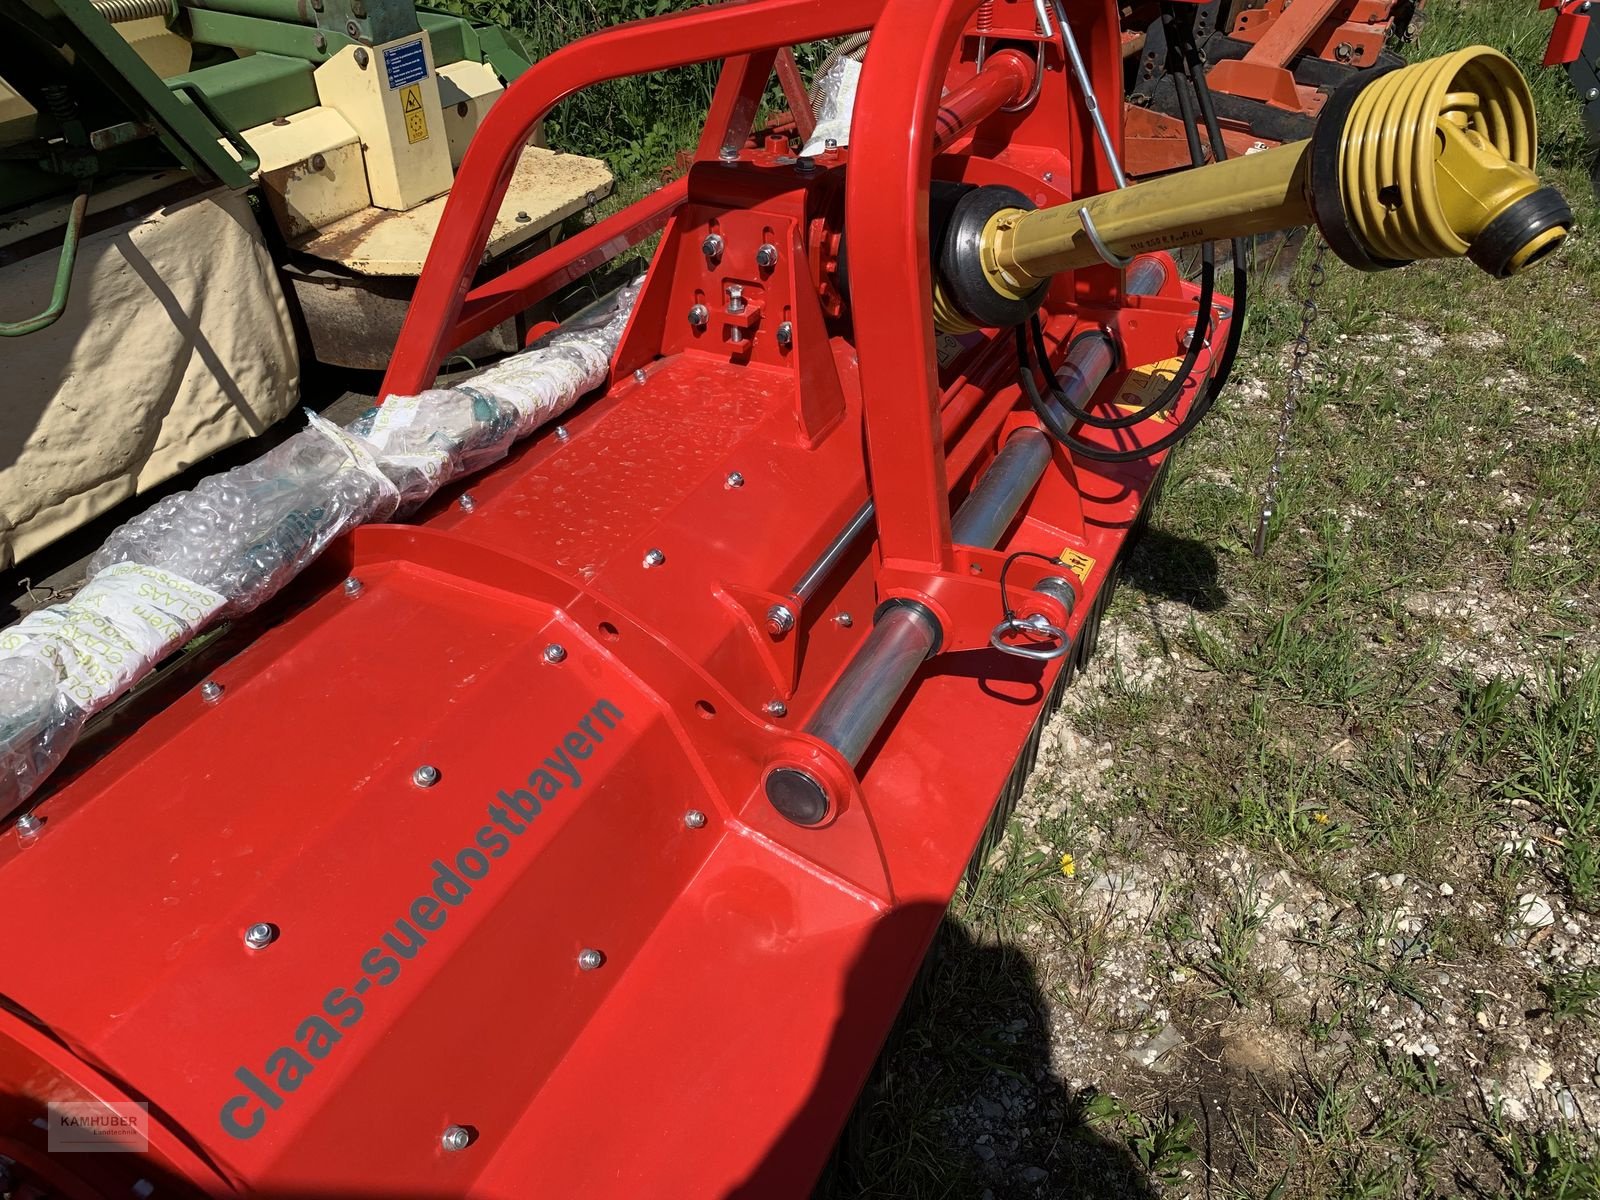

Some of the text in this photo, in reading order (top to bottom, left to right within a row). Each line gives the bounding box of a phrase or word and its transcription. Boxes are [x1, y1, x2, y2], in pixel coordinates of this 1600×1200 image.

[138, 583, 202, 622] CLAAS
[61, 623, 123, 665] CLAAS
[220, 697, 624, 1139] claas-suedostbayern
